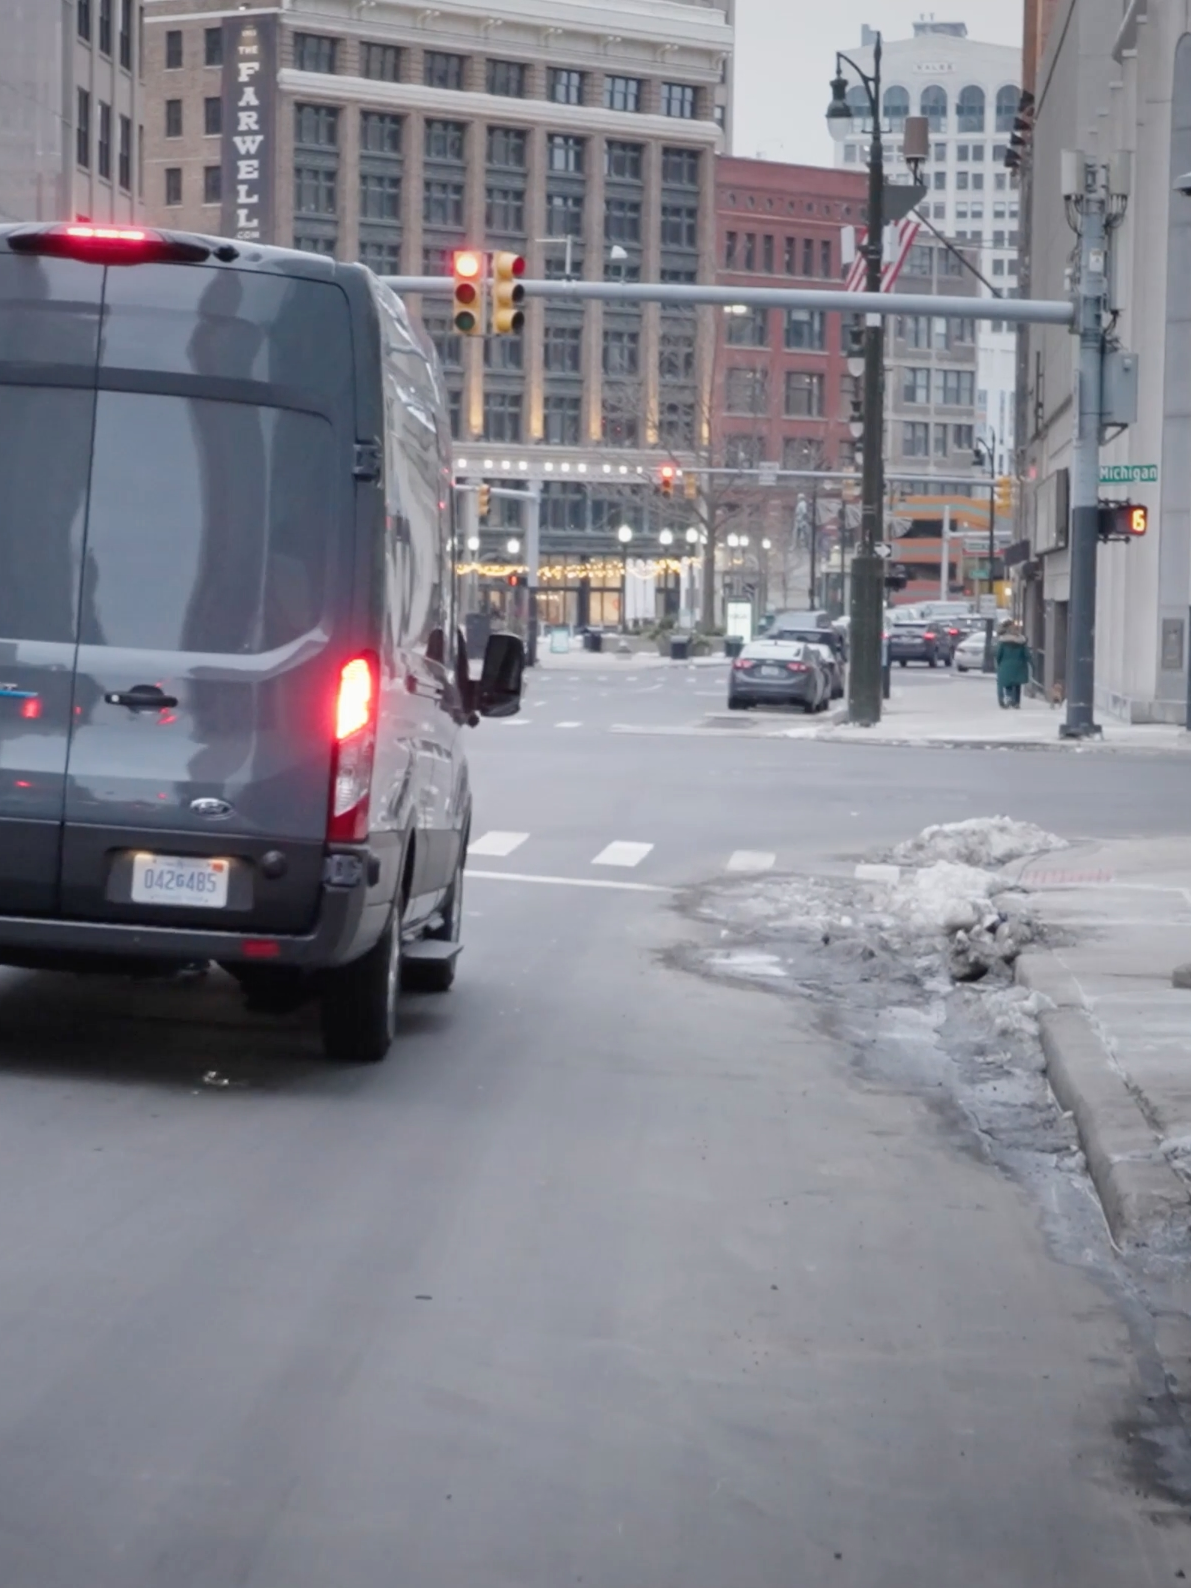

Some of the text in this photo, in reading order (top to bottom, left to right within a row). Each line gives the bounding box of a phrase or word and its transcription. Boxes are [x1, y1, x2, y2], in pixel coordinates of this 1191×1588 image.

[237, 45, 259, 55] THE
[233, 61, 264, 228] FARWELL
[1099, 466, 1158, 483] Michigan
[1132, 509, 1146, 532] 6
